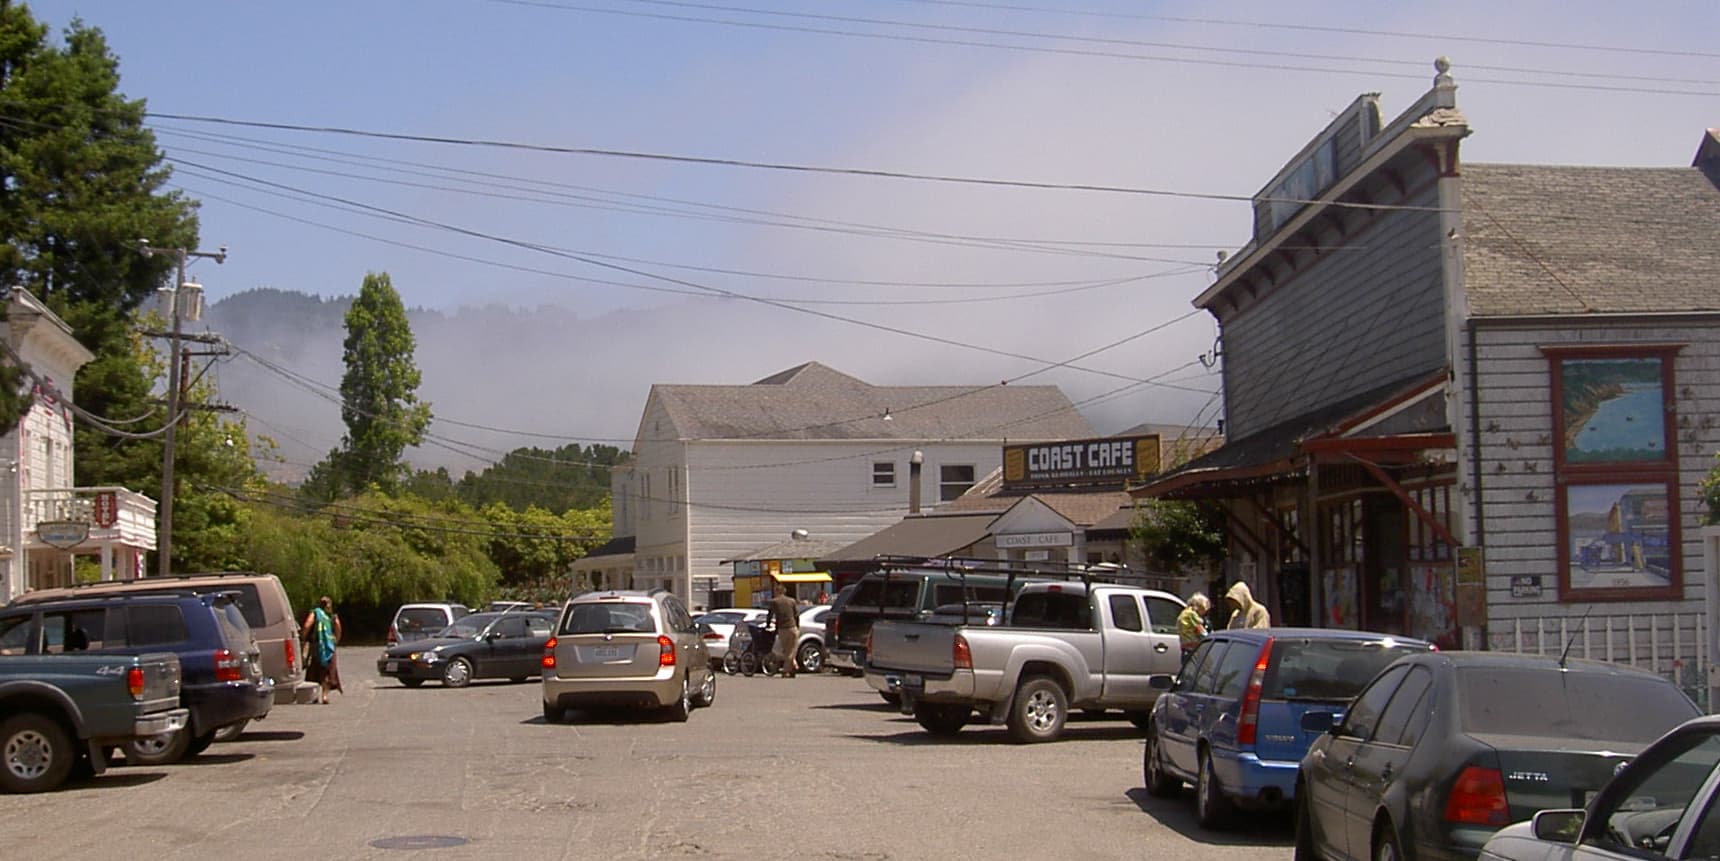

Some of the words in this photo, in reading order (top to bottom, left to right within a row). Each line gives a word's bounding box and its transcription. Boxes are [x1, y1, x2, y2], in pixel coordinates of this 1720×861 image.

[1028, 445, 1084, 471] COAST
[1088, 441, 1132, 467] CAFE
[1006, 535, 1031, 545] COAST
[1039, 534, 1059, 544] CAFE
[1520, 577, 1532, 585] NO
[1513, 585, 1541, 597] PARKING
[1509, 771, 1548, 781] JETTA
